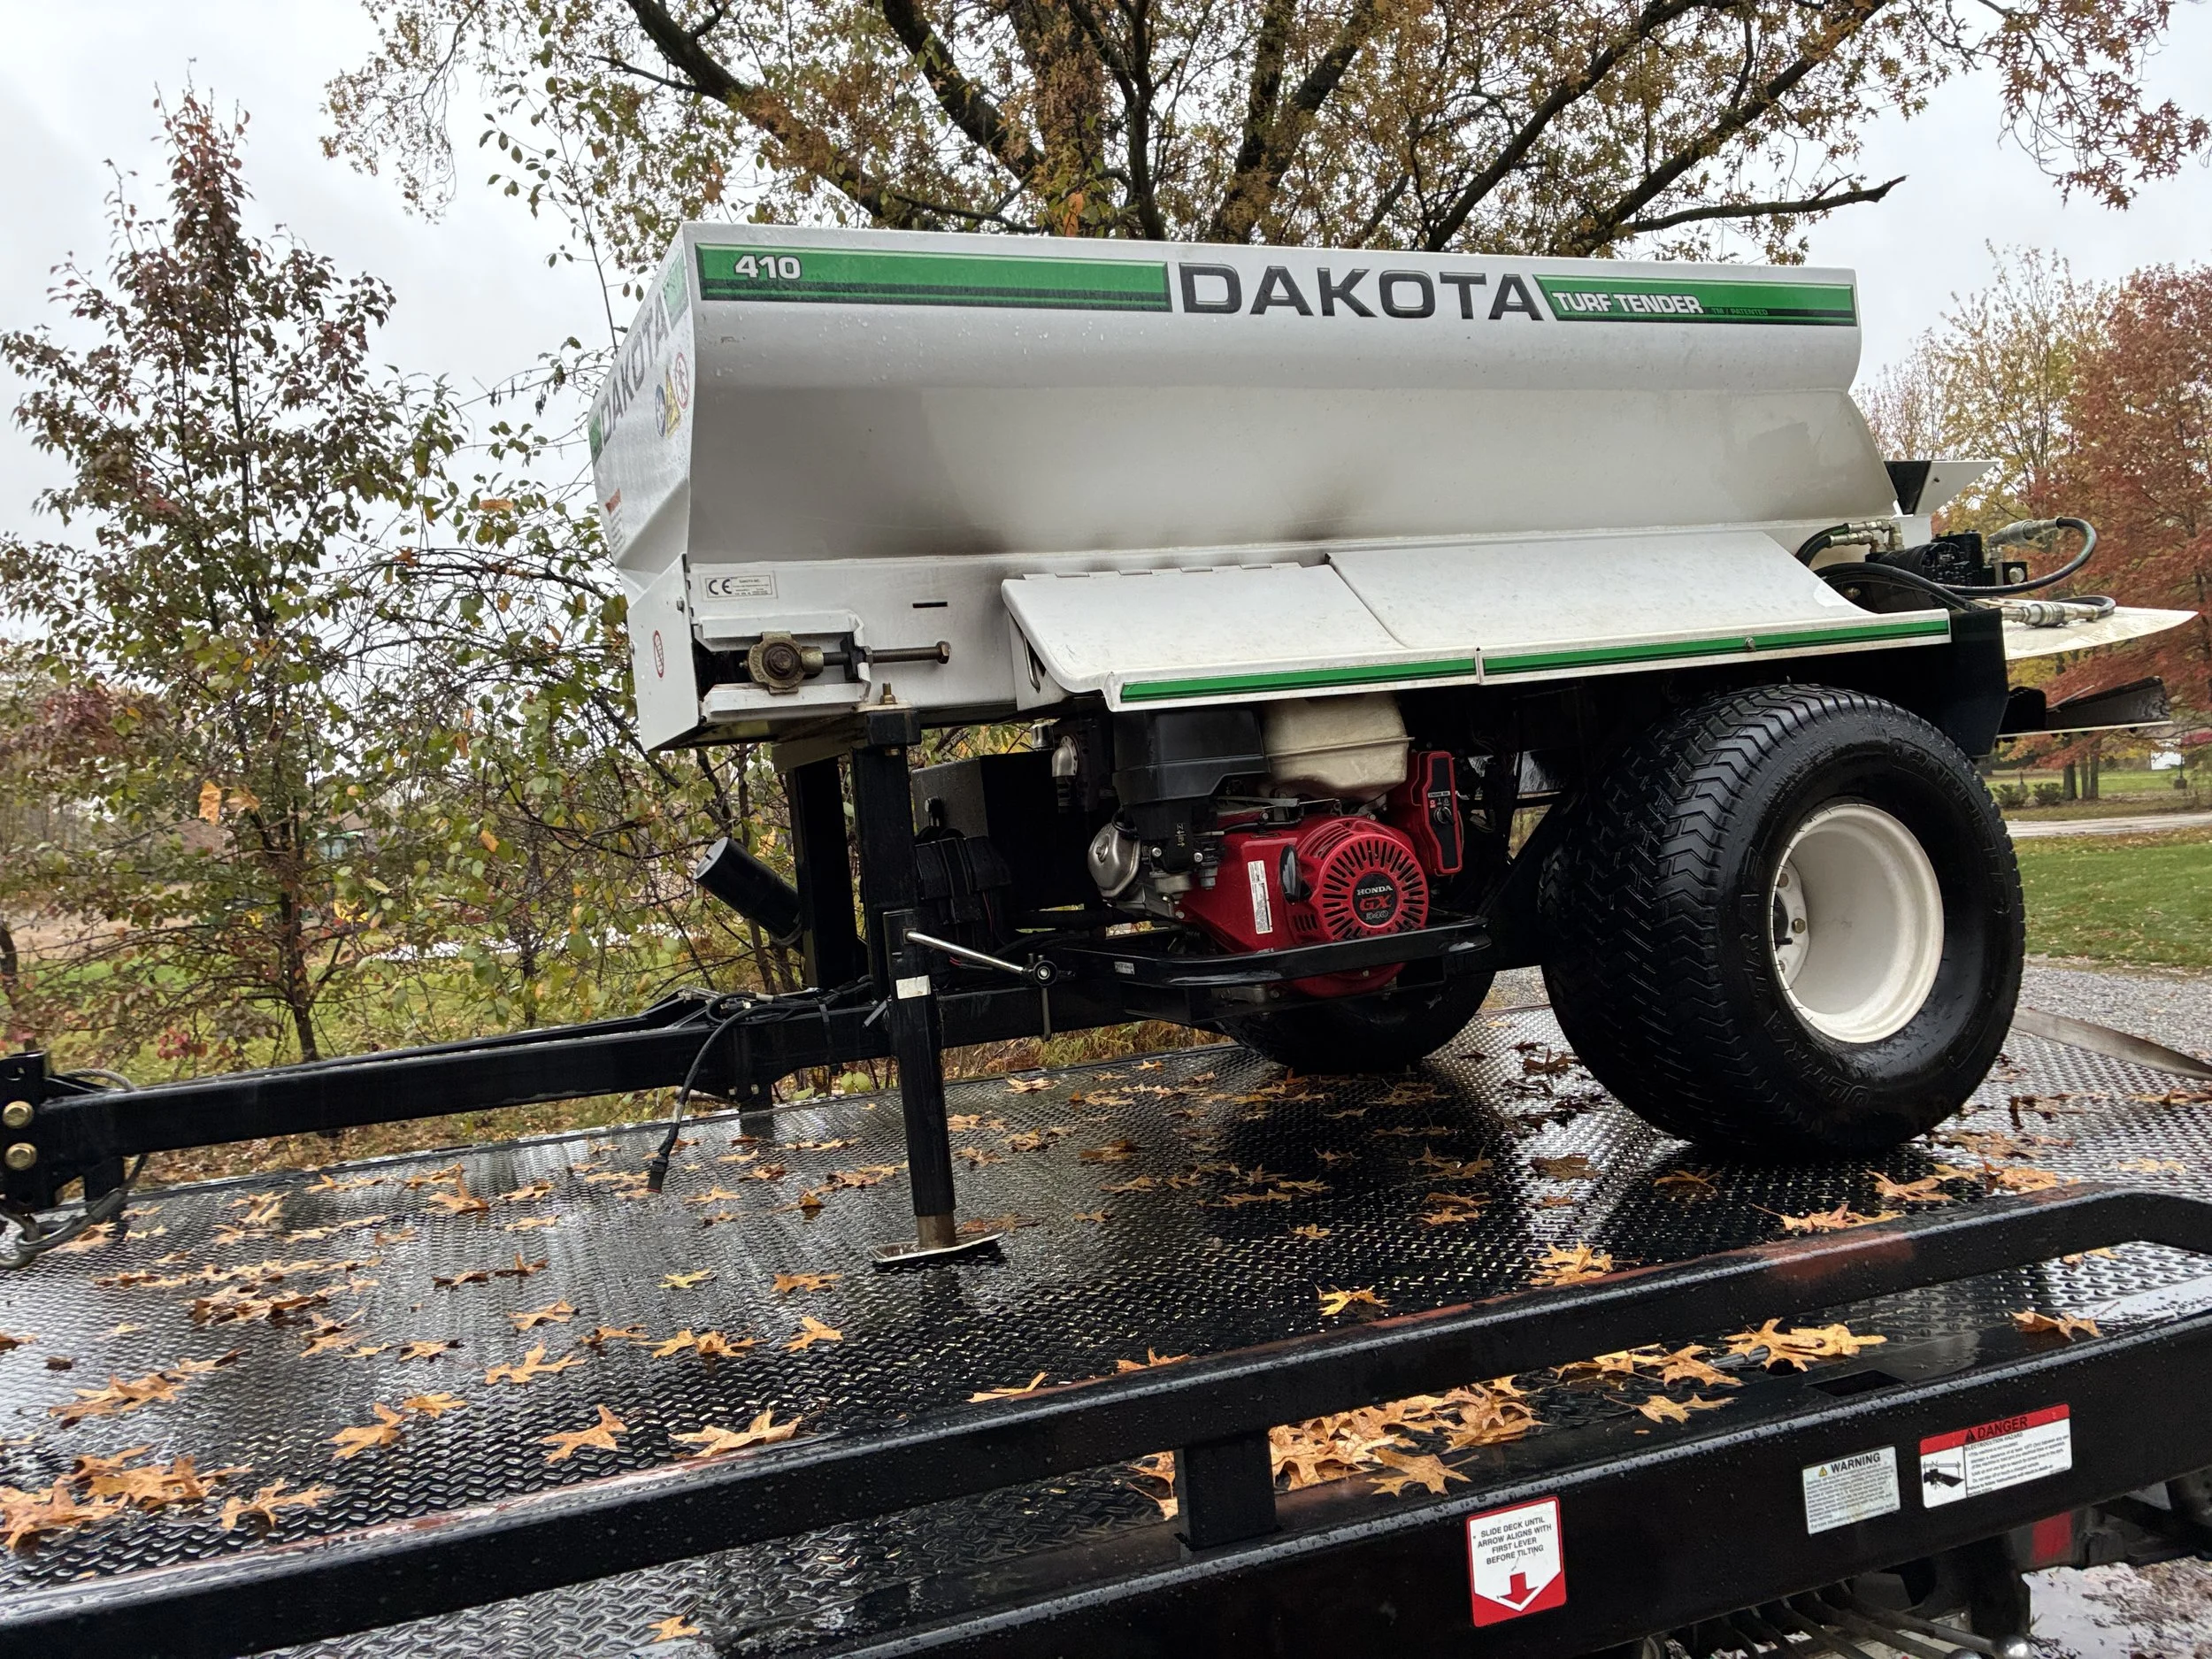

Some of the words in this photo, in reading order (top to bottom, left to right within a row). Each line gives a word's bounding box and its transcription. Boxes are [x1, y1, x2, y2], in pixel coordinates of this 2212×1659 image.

[734, 254, 802, 280] 410
[1178, 261, 1545, 322] DAKOTA
[1552, 292, 1613, 312] TURF
[1614, 293, 1705, 314] TENDER
[600, 292, 670, 447] DAKOTA
[708, 578, 733, 595] CE
[1356, 885, 1394, 896] HONDA
[1359, 894, 1392, 911] GX
[1977, 1416, 2028, 1440] DANGER
[1830, 1452, 1881, 1474] WARNING
[1478, 1535, 1504, 1548] ARROW
[1507, 1528, 1532, 1541] ALIGNS
[1533, 1523, 1552, 1534] WITH
[1480, 1526, 1502, 1538] SLIDE
[1503, 1521, 1523, 1532] DECK
[1525, 1516, 1545, 1527] UNTIL
[1486, 1551, 1516, 1565] BEFORE
[1517, 1544, 1544, 1557] TILTING
[1492, 1542, 1512, 1555] FIRST
[1514, 1536, 1537, 1549] LEVER
